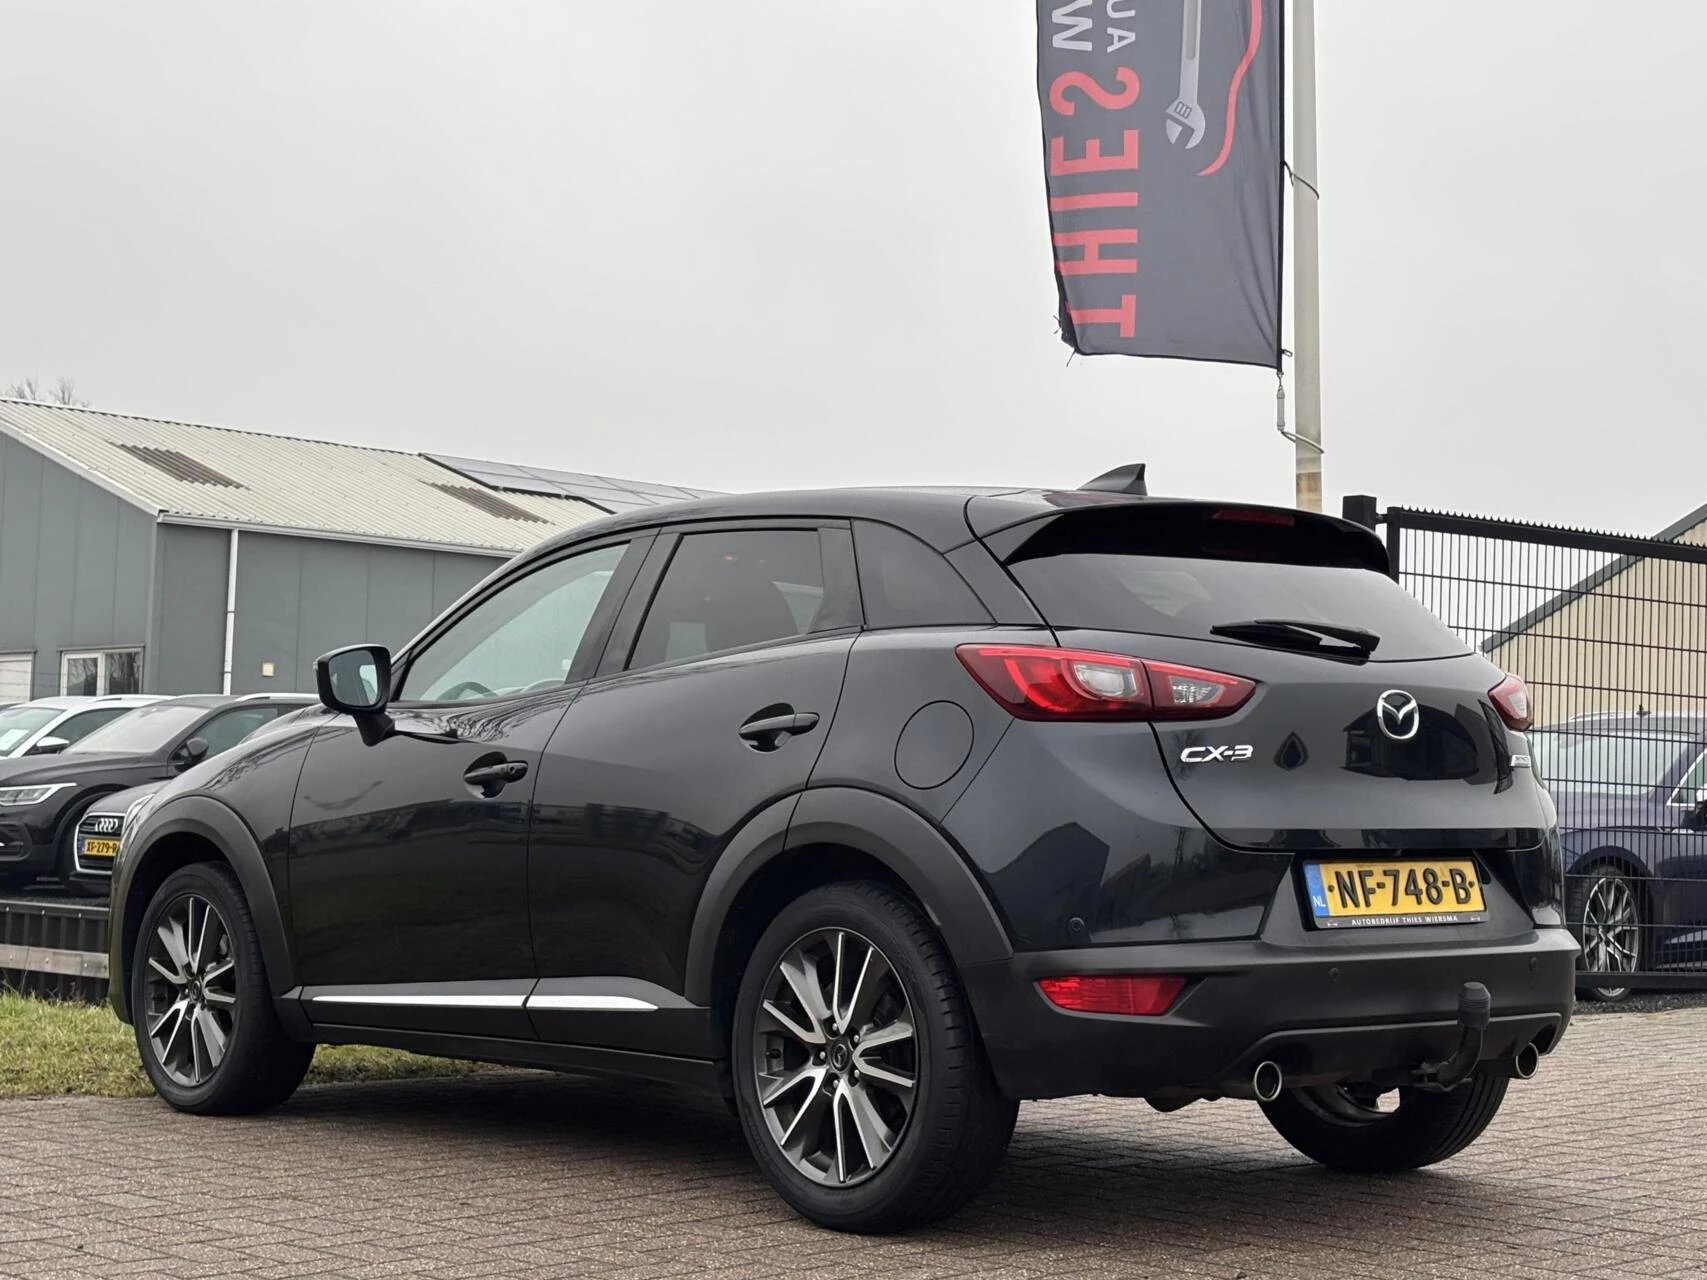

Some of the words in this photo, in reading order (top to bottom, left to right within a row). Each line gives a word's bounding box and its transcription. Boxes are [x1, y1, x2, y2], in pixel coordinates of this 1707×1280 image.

[1180, 745, 1254, 763] CX-3
[1335, 868, 1471, 908] NF-748-B
[1313, 896, 1326, 907] NL
[1402, 916, 1422, 924] THIES
[1424, 914, 1458, 923] WIERSMA
